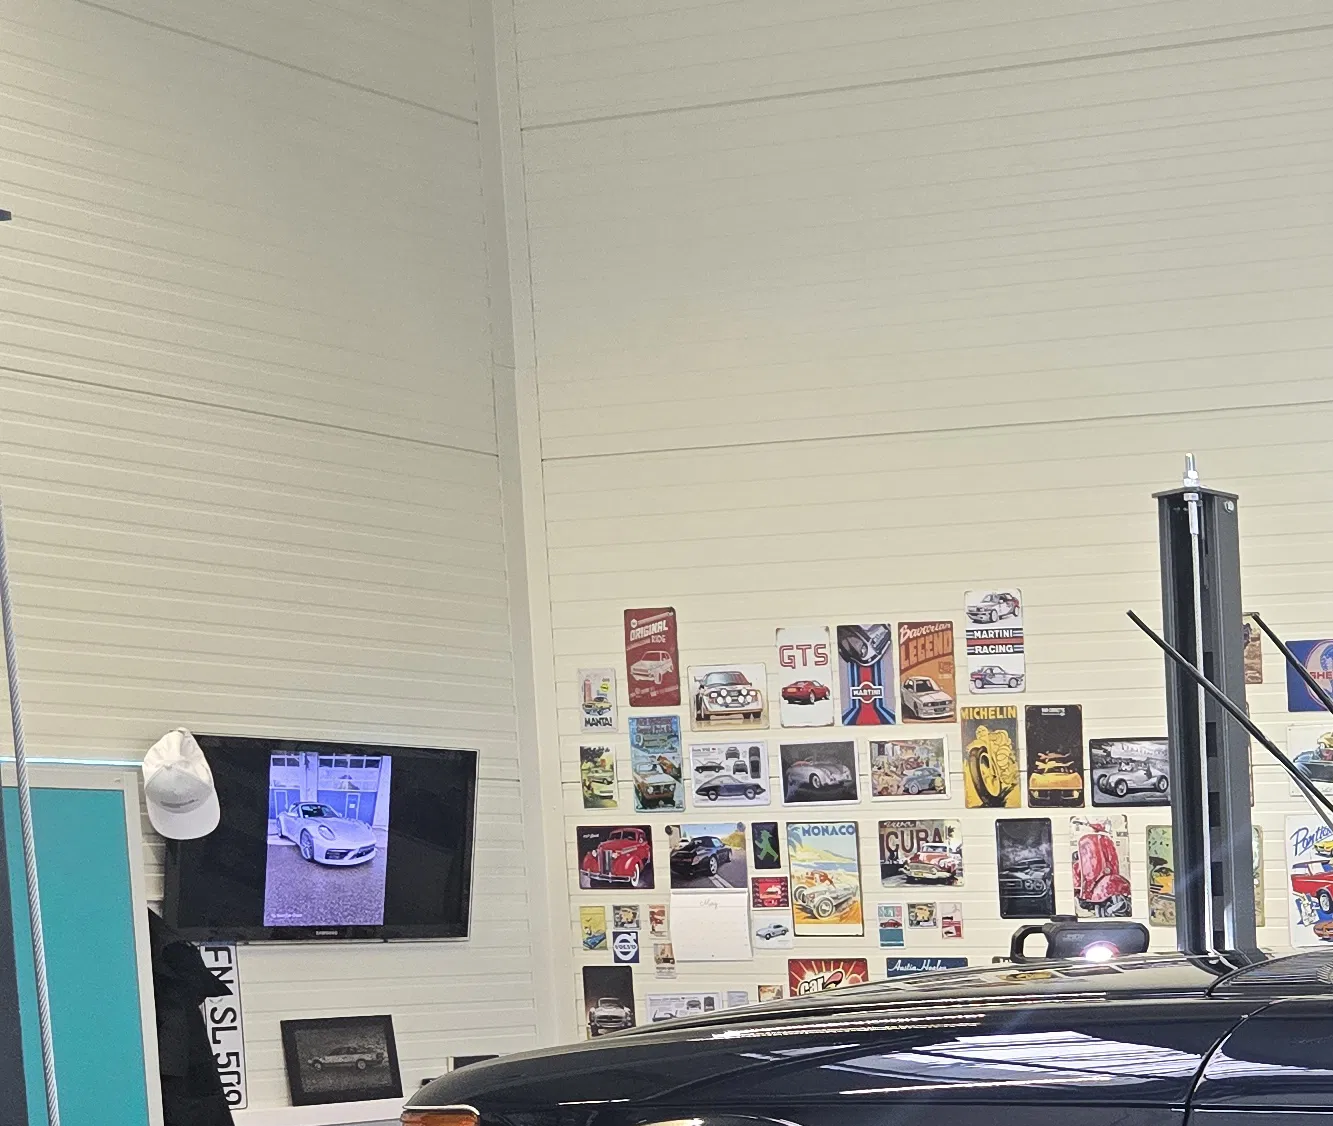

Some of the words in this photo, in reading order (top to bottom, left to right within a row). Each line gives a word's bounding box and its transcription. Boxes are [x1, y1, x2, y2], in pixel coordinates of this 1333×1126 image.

[630, 619, 669, 642] ORIGINAL
[974, 629, 1014, 640] MARTINI
[651, 634, 667, 644] RIDE
[779, 643, 829, 669] GTS
[900, 630, 954, 670] LEGEND
[974, 644, 1015, 655] RACING
[853, 688, 882, 697] MARTINI
[960, 706, 1018, 721] MICHELIN
[584, 717, 613, 727] MANTA!
[802, 824, 855, 837] MONACO
[886, 826, 944, 853] CUBA
[209, 1006, 237, 1046] SL
